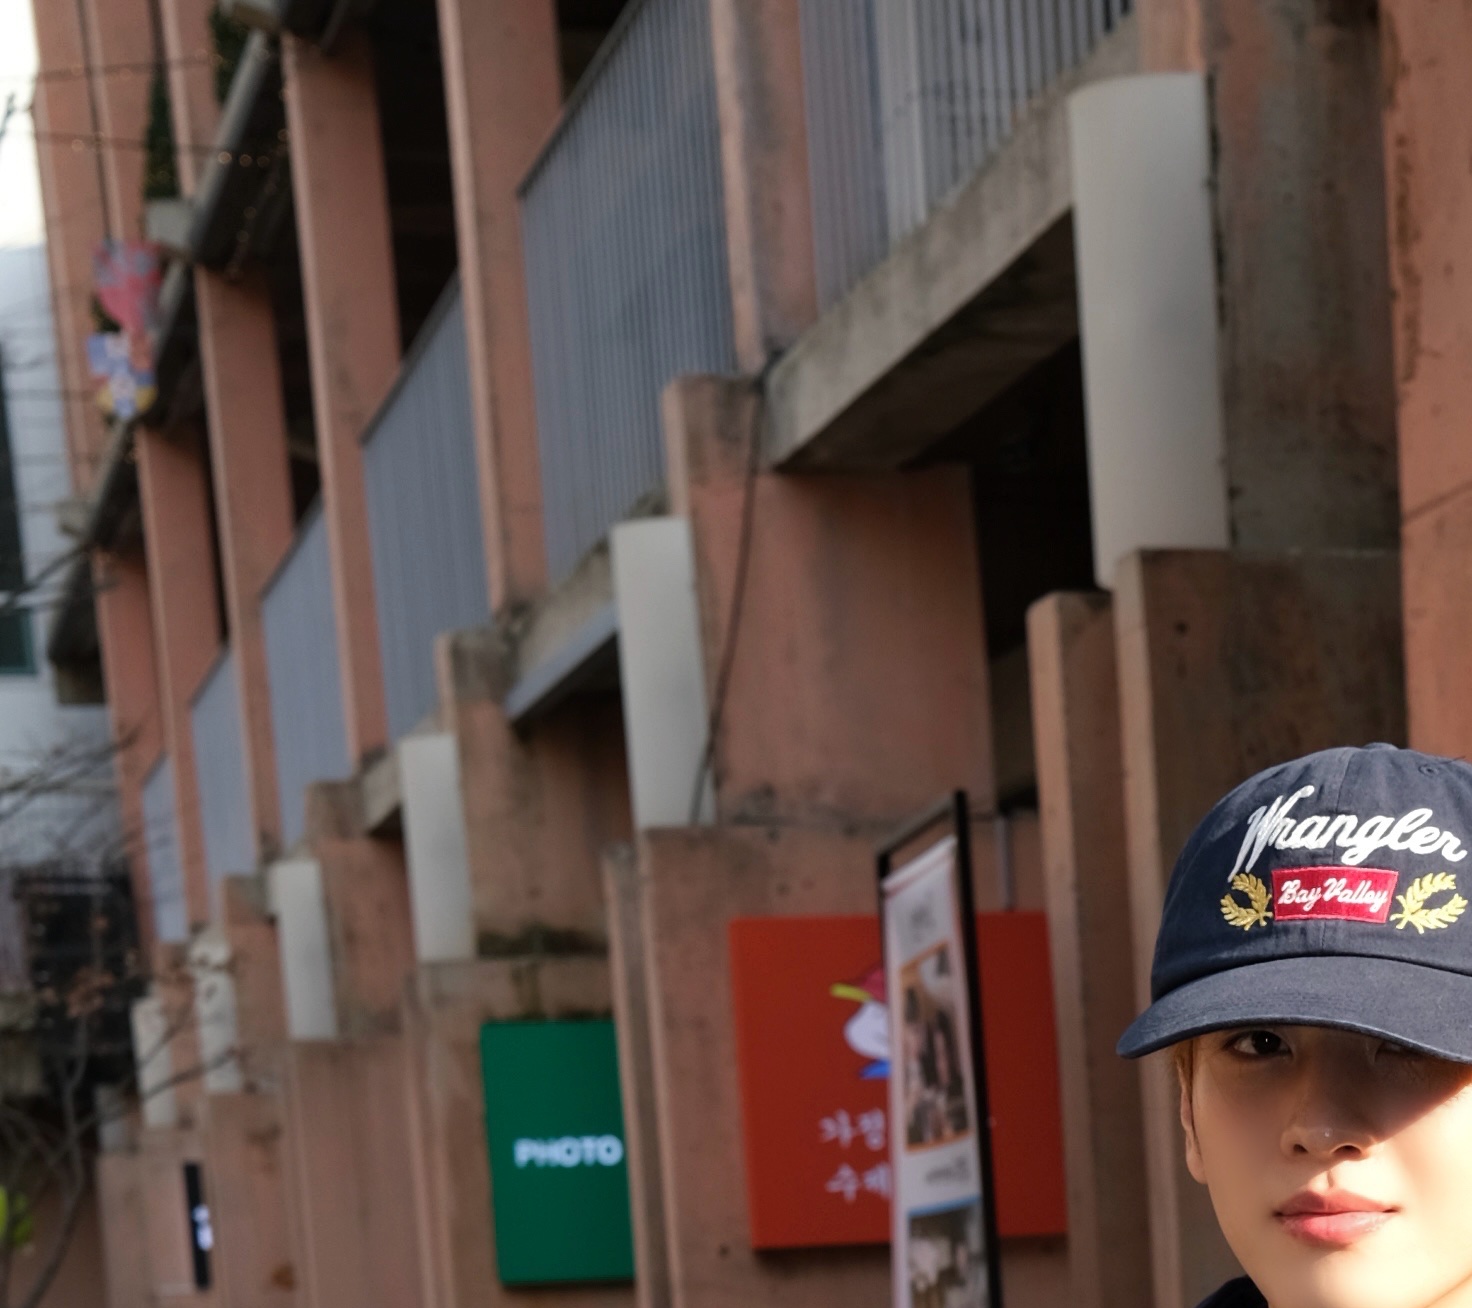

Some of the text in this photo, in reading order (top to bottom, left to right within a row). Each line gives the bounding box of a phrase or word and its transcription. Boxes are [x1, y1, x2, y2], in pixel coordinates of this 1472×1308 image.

[1227, 785, 1468, 882] Wrangler
[1278, 877, 1388, 913] Bay Valley
[514, 1133, 624, 1169] PHOTO
